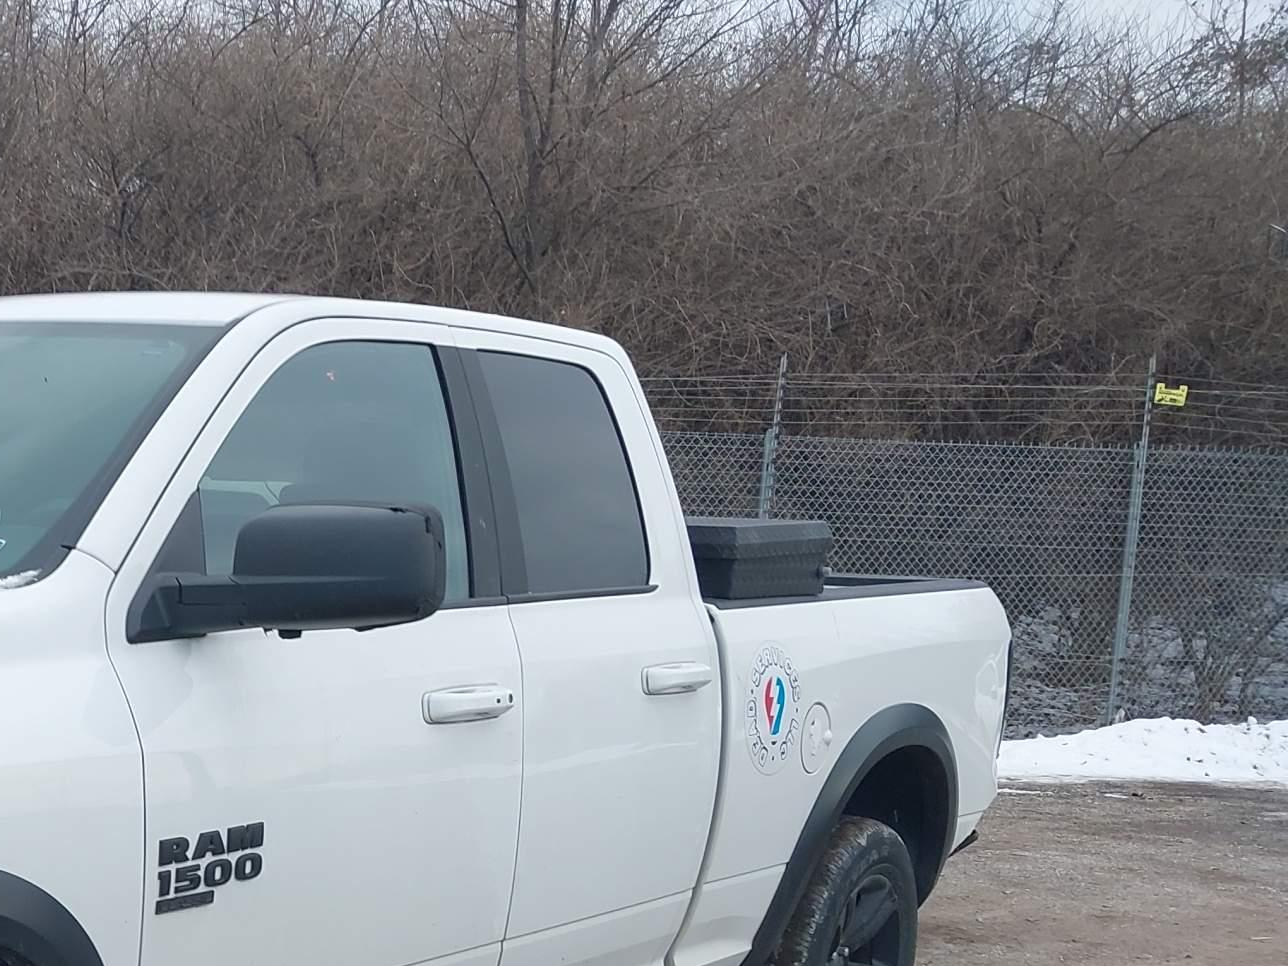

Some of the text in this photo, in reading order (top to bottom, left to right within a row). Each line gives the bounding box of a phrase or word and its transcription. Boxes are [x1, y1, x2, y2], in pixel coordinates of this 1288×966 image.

[752, 647, 800, 702] SERVICES
[779, 718, 801, 761] LLC
[158, 822, 264, 866] RAM
[157, 853, 263, 898] 1500
